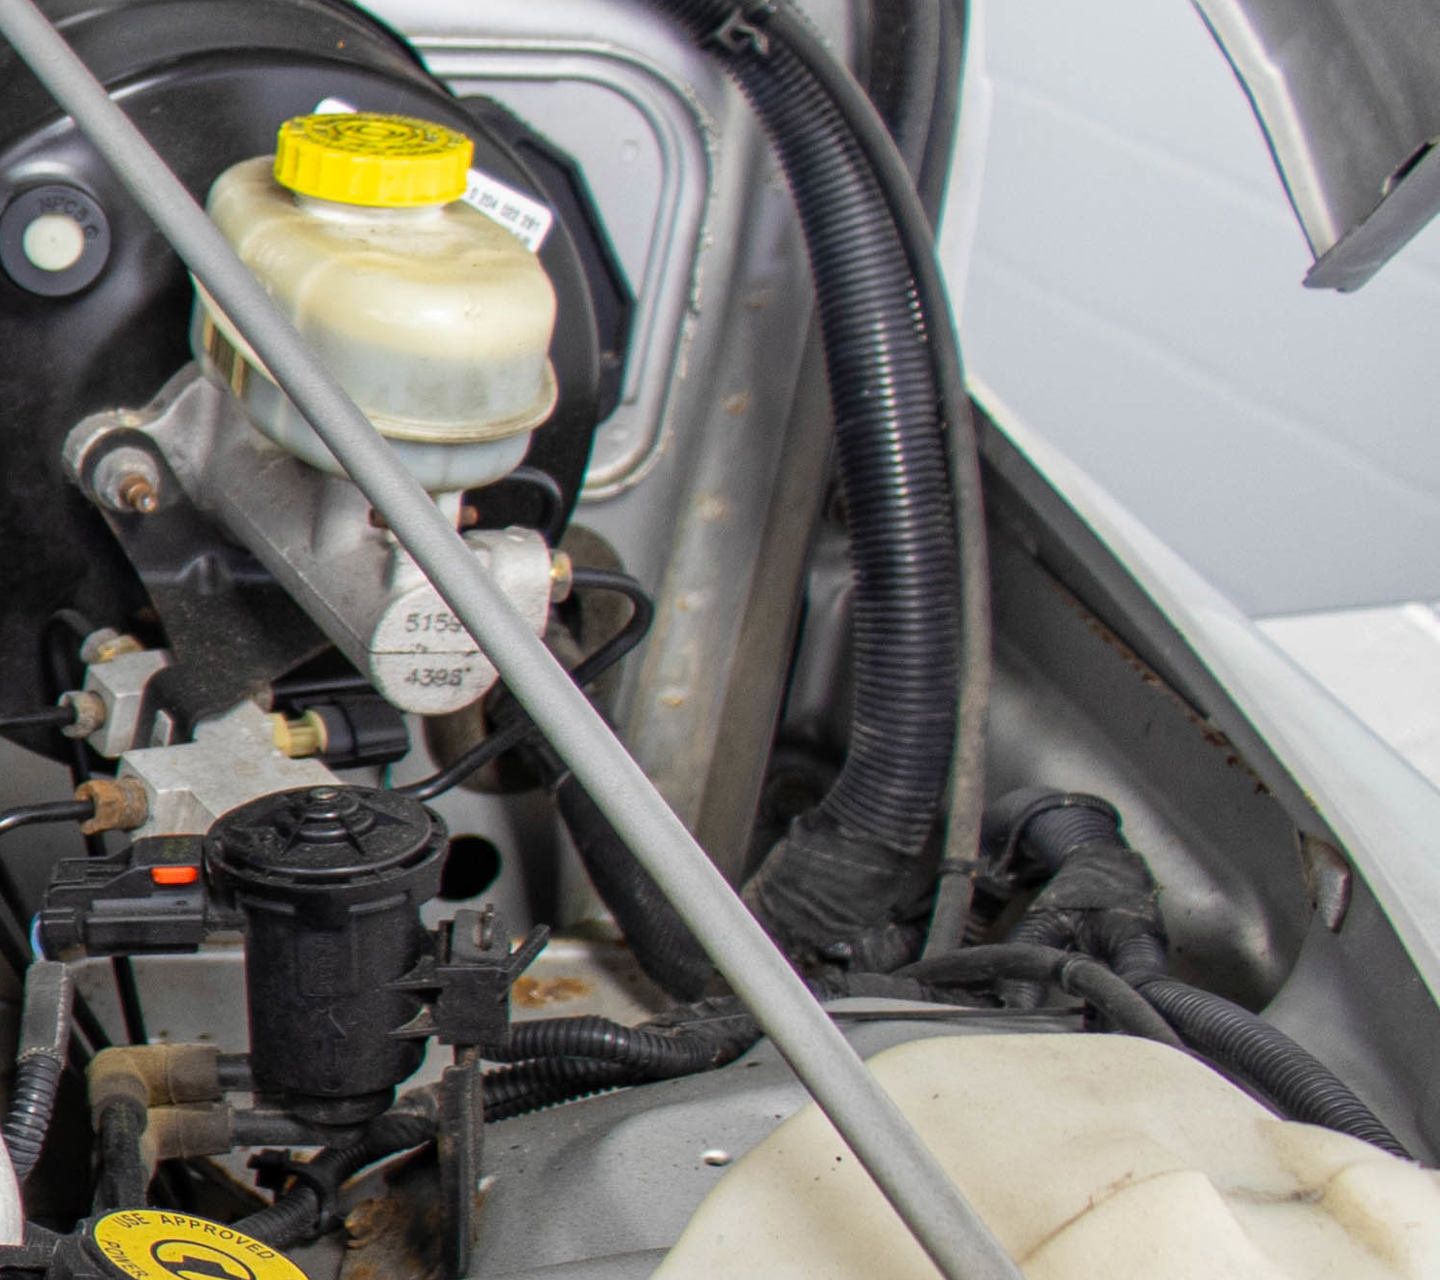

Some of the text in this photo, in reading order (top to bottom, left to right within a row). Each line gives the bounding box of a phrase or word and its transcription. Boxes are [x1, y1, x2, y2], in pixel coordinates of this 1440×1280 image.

[111, 1211, 275, 1261] USE APPROVED
[102, 1239, 149, 1280] POWER
